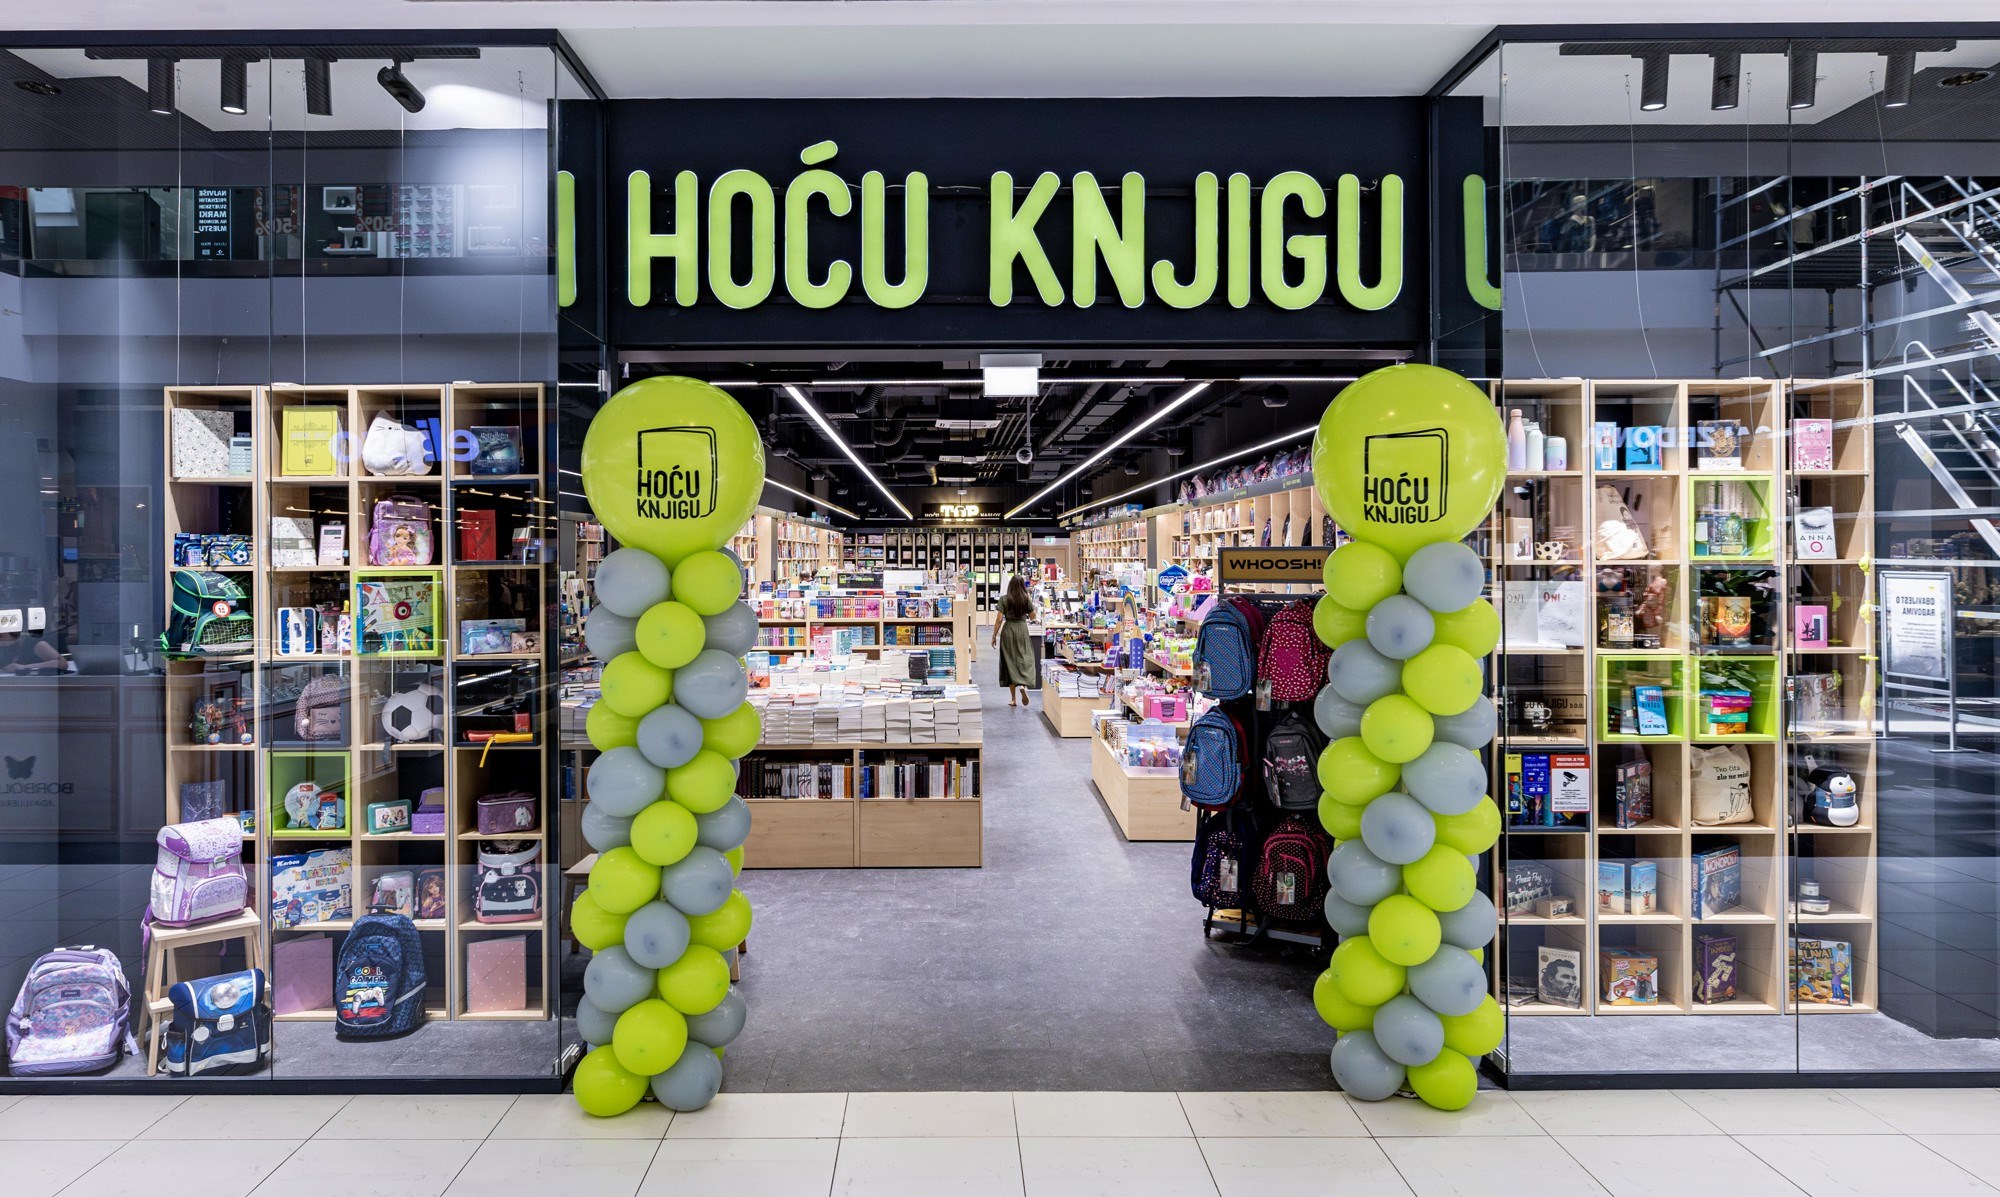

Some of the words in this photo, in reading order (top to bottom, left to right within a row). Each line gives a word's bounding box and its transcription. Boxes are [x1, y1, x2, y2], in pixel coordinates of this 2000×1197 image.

[627, 139, 930, 310] HOĆU
[988, 170, 1405, 311] KNJIGU
[637, 464, 700, 499] HOĆU
[1363, 472, 1429, 506] HOĆU
[637, 498, 700, 520] KNJIGU
[940, 505, 980, 518] TOP
[1363, 503, 1429, 524] KNJIGU
[1229, 558, 1322, 570] WHOOSH!
[369, 585, 415, 605] ART
[1507, 593, 1524, 604] ONI
[1543, 591, 1561, 602] ONI
[276, 859, 300, 867] Karbon
[1705, 851, 1739, 873] MONOPOLY
[1802, 948, 1833, 960] LAVA!
[355, 966, 383, 976] COOL
[349, 975, 387, 983] GAMER
